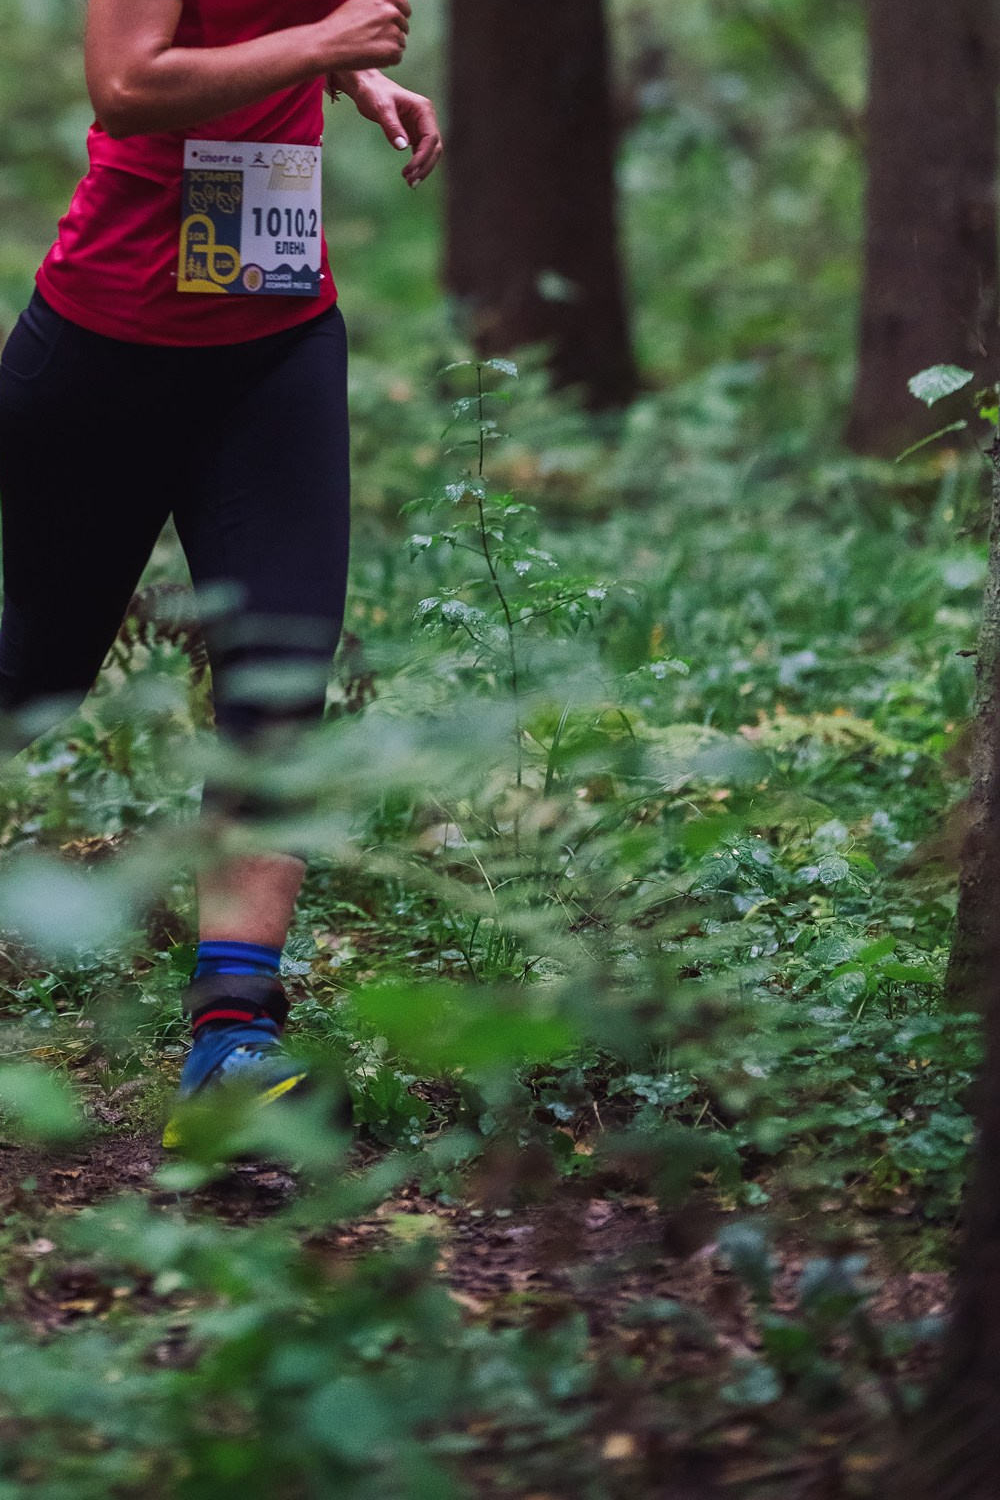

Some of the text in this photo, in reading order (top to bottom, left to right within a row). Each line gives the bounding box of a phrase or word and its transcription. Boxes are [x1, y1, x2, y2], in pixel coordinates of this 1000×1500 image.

[199, 155, 229, 164] СПОРТ
[252, 207, 317, 238] 1010.2
[275, 241, 306, 255] ЕЛЕНА
